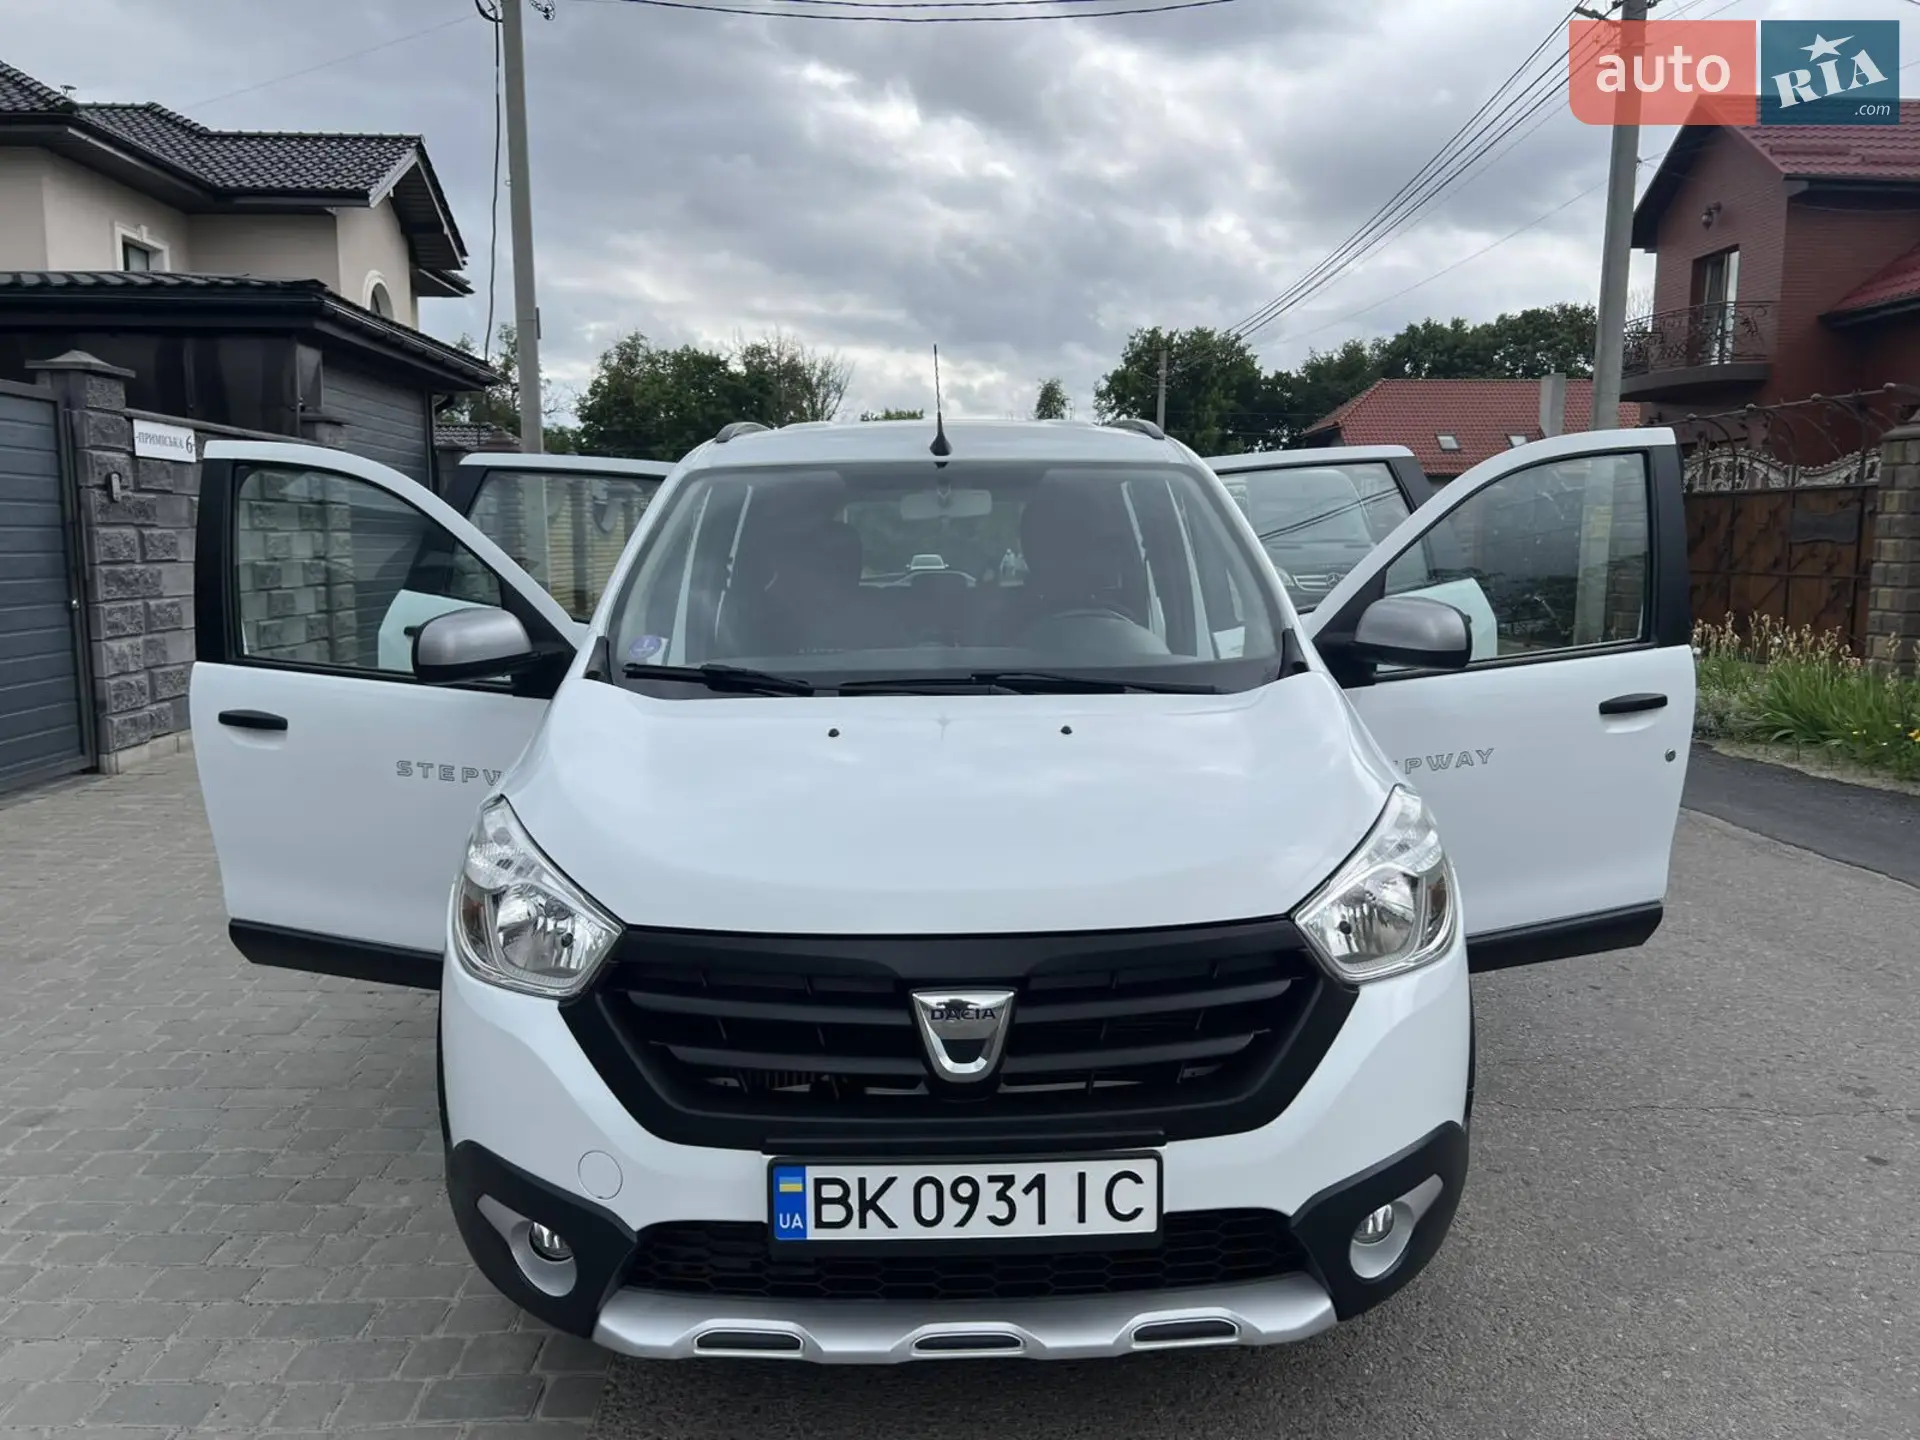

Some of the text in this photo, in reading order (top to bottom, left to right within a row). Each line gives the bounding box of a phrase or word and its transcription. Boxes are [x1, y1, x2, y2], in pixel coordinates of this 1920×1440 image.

[185, 435, 194, 454] 6
[1393, 748, 1495, 775] PWAY
[930, 1007, 996, 1021] DACIA
[813, 1170, 1144, 1229] BK 0931 IC
[778, 1213, 804, 1229] UA
